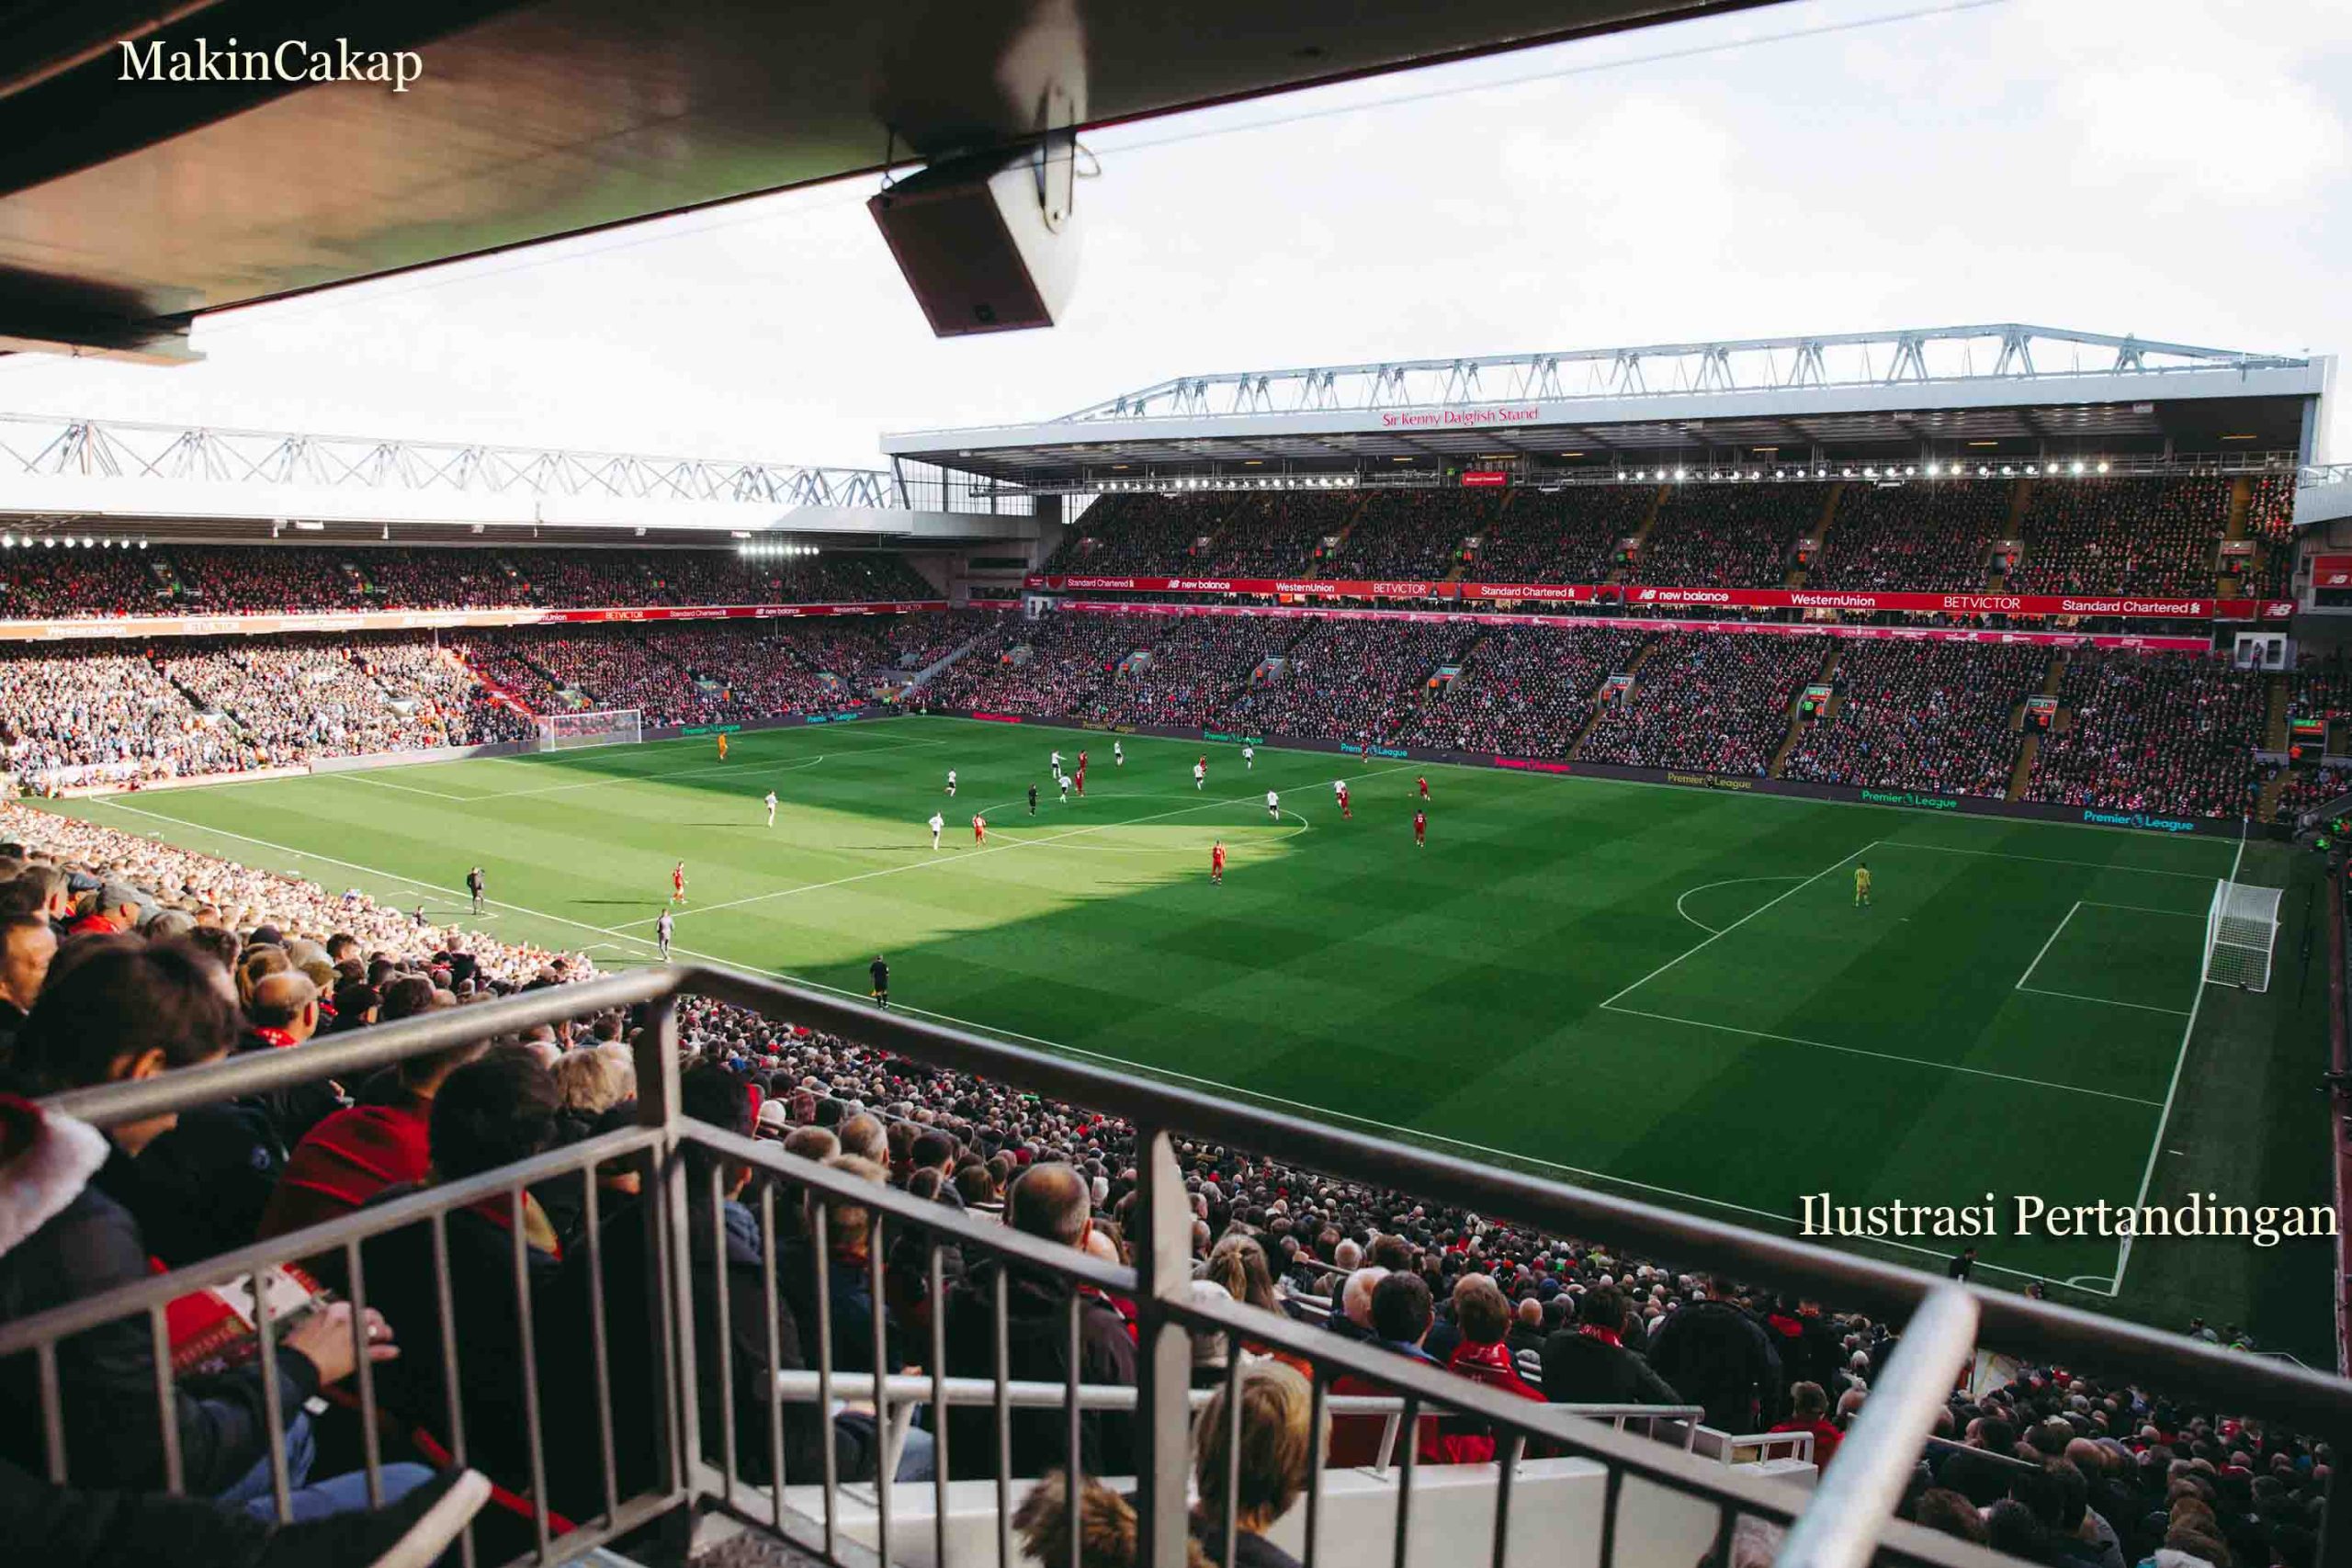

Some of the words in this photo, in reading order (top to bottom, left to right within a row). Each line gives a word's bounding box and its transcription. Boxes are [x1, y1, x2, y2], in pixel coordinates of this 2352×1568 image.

[1383, 413, 1396, 426] Sir
[1401, 412, 1441, 426] Kenny
[1444, 410, 1496, 426] Dalglish
[1498, 408, 1539, 422] Stand
[1068, 579, 1096, 588] Standard
[1097, 579, 1129, 588] Chartered
[1198, 580, 1230, 590] balance
[1275, 582, 1335, 592] WesternUnion
[1374, 583, 1426, 594] BETVICTOR
[1481, 586, 1521, 596] Standard
[1522, 586, 1567, 597] Chartered
[1658, 592, 1681, 601] new
[1682, 591, 1729, 602] balance
[1791, 593, 1875, 606] WesternUnion
[1943, 596, 2021, 609] BETVICTOR
[777, 606, 800, 615] balance
[2062, 600, 2120, 612] Standard
[2122, 601, 2189, 614] Chartered
[605, 611, 644, 620] BETVICTOR
[1379, 746, 1408, 758] League
[1668, 773, 1704, 784] Premier
[1714, 776, 1752, 789] League
[1861, 790, 1903, 803] Premier
[1915, 795, 1958, 808] League
[2084, 810, 2131, 824] Premier
[2145, 816, 2194, 831] League
